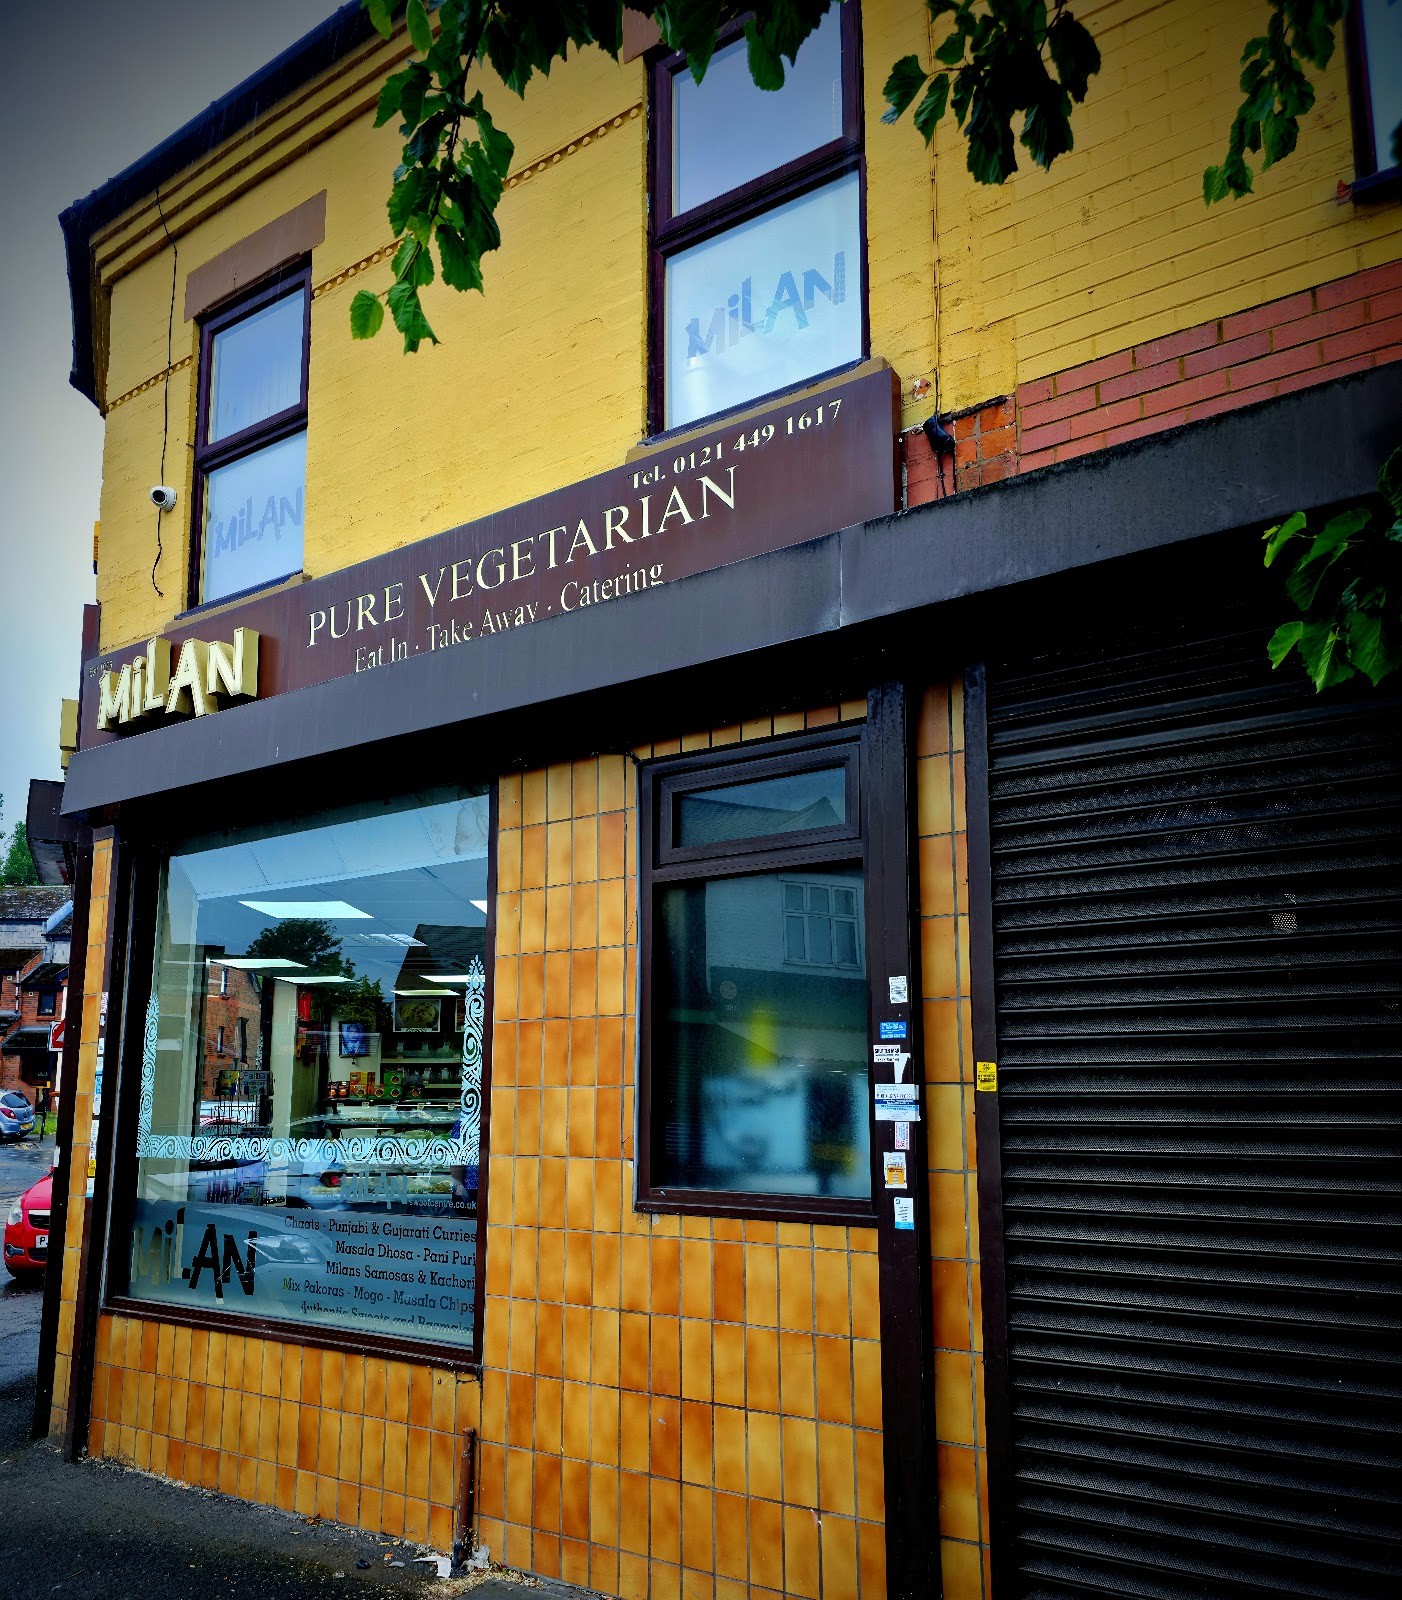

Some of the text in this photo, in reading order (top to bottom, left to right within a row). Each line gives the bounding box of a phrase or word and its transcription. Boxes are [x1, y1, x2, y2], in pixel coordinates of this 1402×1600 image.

[628, 399, 842, 489] Tel. 0121 449 1617
[215, 486, 302, 558] MiLAN
[307, 464, 739, 648] PURE VEGETARIAN
[355, 645, 383, 673] Eat
[390, 637, 408, 663] In
[426, 619, 473, 652] Take
[480, 602, 538, 637] Away
[560, 563, 663, 612] Catering
[97, 627, 259, 730] MiLAN
[285, 1215, 320, 1231] Chaats
[329, 1219, 368, 1236] Punjabi
[372, 1222, 379, 1235] &
[383, 1222, 429, 1240] Gujarati
[433, 1226, 477, 1242] Curries
[336, 1240, 374, 1256] Masala
[378, 1244, 413, 1260] Dhosa
[423, 1248, 448, 1263] Pani
[452, 1251, 476, 1266] Puri
[283, 1278, 300, 1291] Mix
[305, 1280, 344, 1297] Pakoras
[354, 1286, 383, 1304] Mogo
[393, 1290, 436, 1308] Masala
[440, 1296, 475, 1315] Chips
[326, 1261, 475, 1289] Milans Samosas & Kachori
[393, 1315, 414, 1328] and
